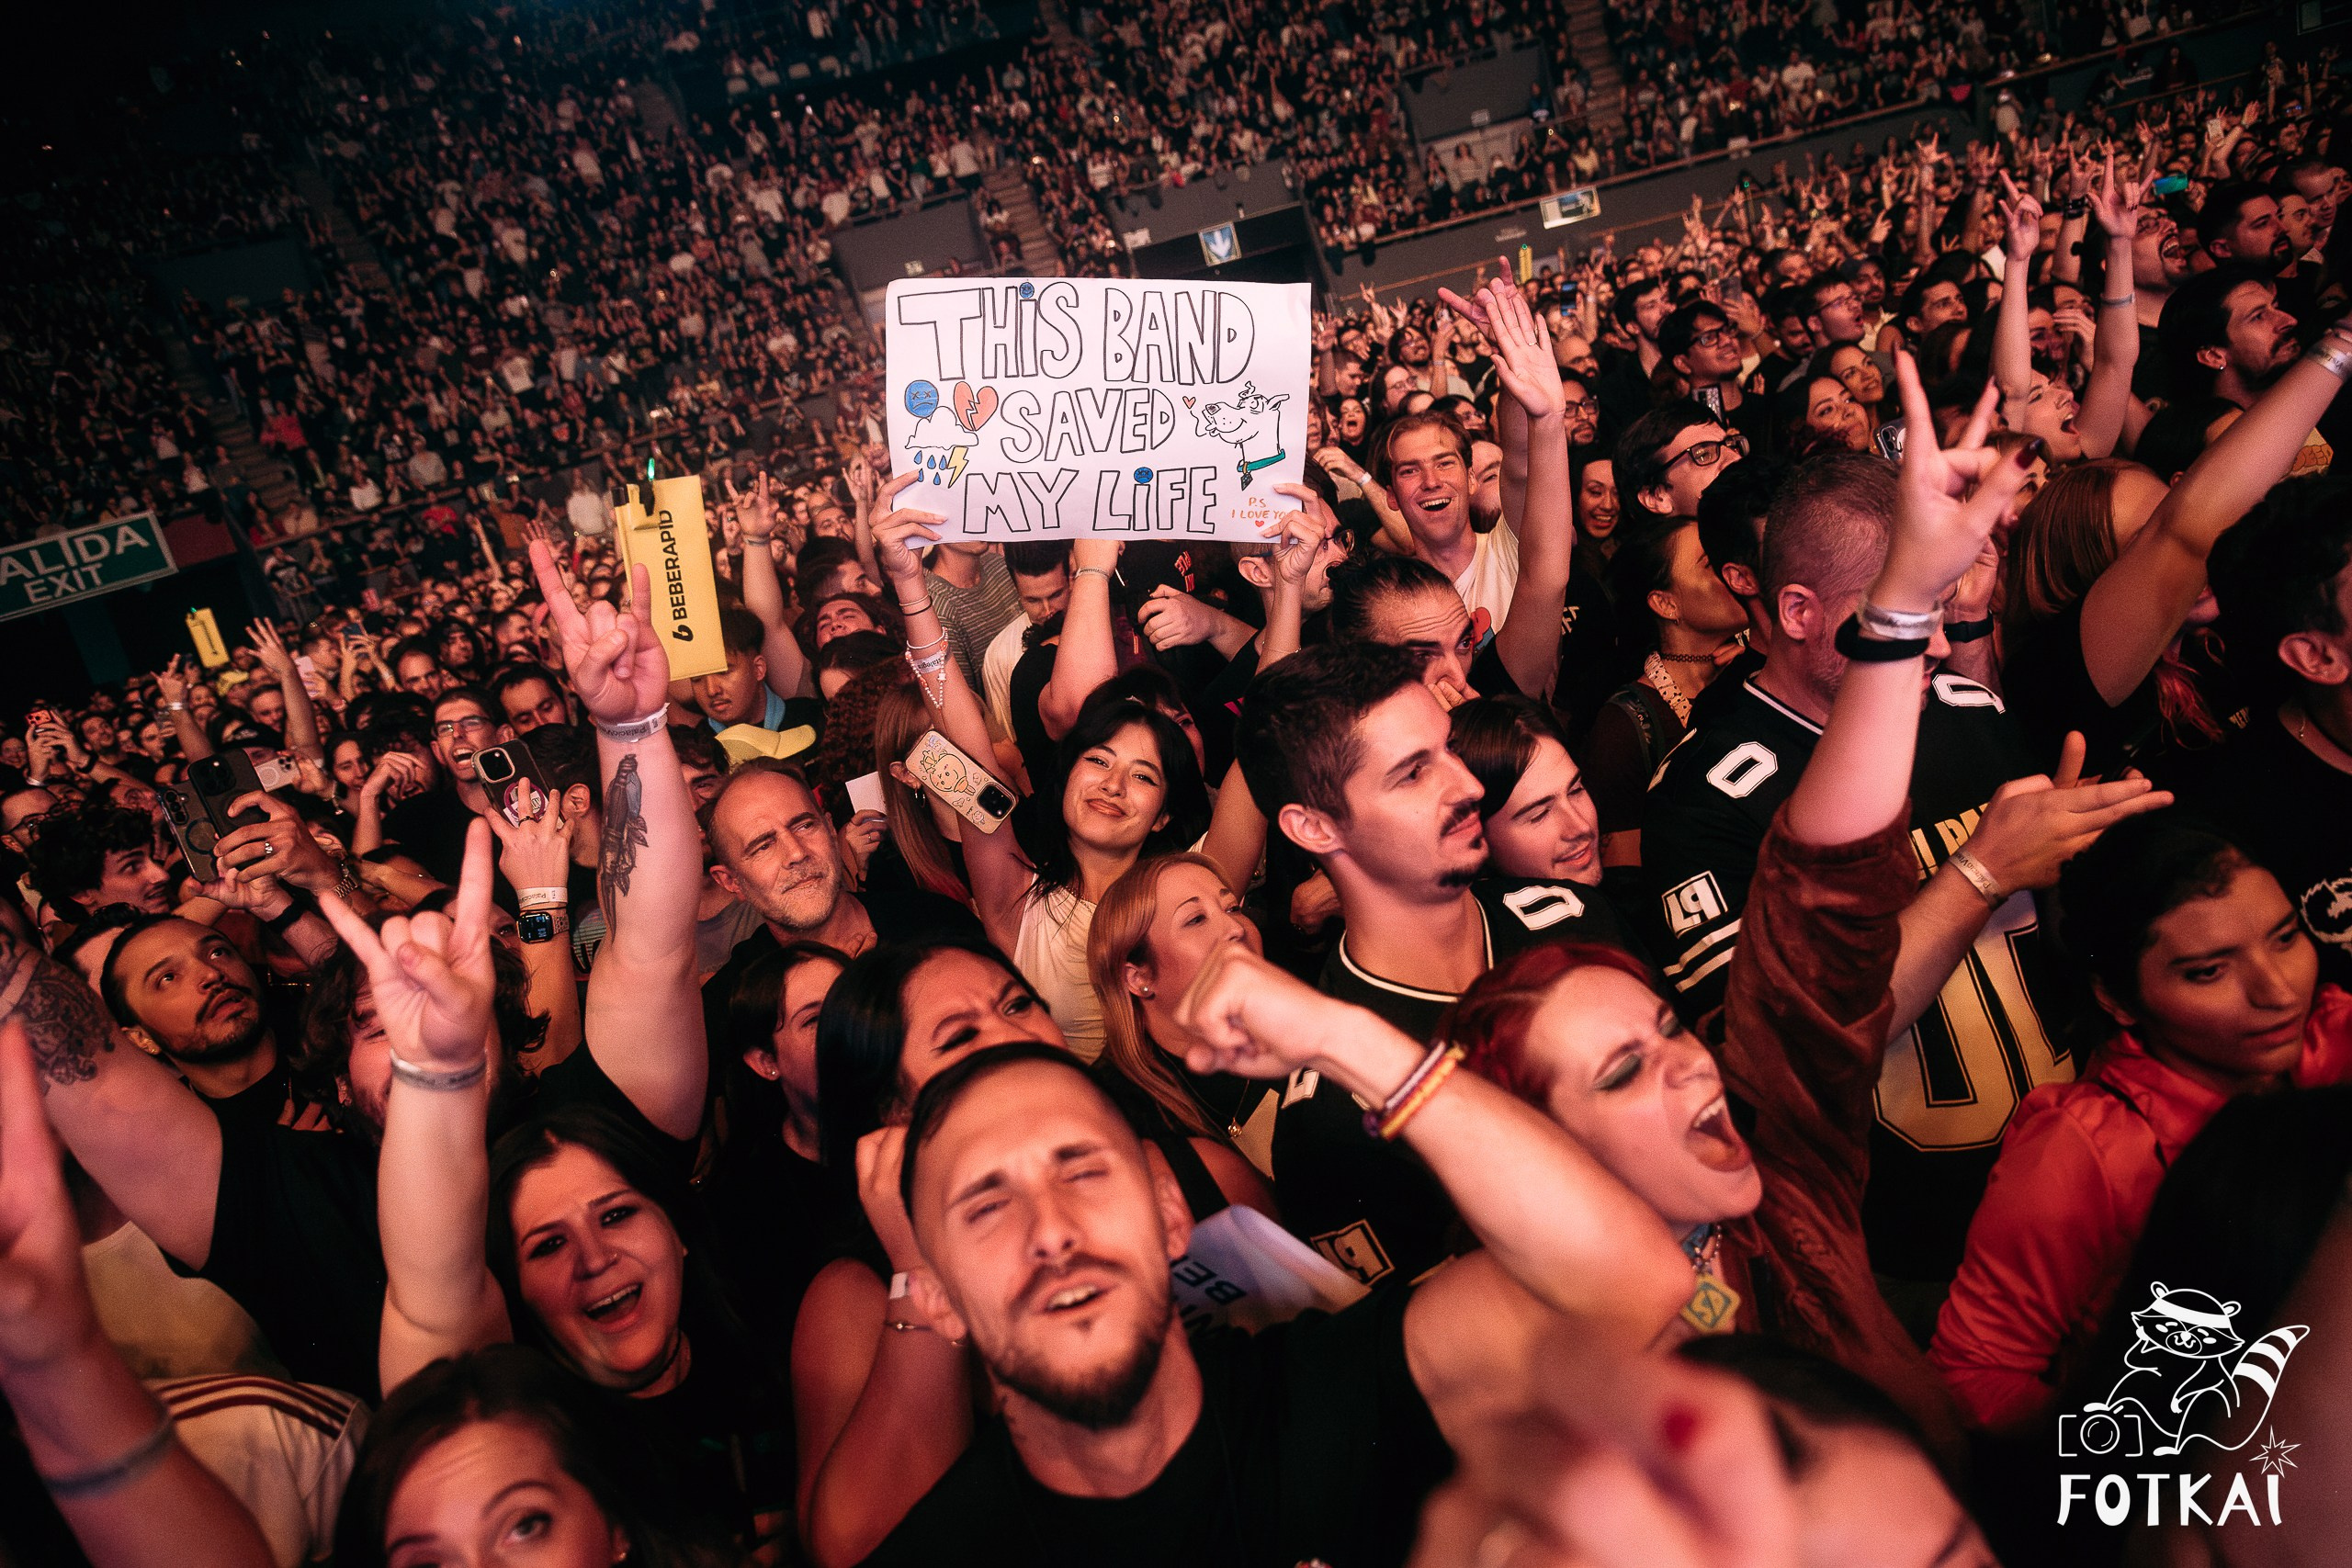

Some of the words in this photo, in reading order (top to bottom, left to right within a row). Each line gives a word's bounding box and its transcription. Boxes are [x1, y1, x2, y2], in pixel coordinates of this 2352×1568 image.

[1103, 288, 1255, 386] BAND
[1000, 387, 1176, 463] SAVED
[963, 468, 1079, 535] MY
[1240, 510, 1270, 519] LOVE
[24, 562, 103, 604] EXIT
[659, 510, 688, 621] BEBERAPID
